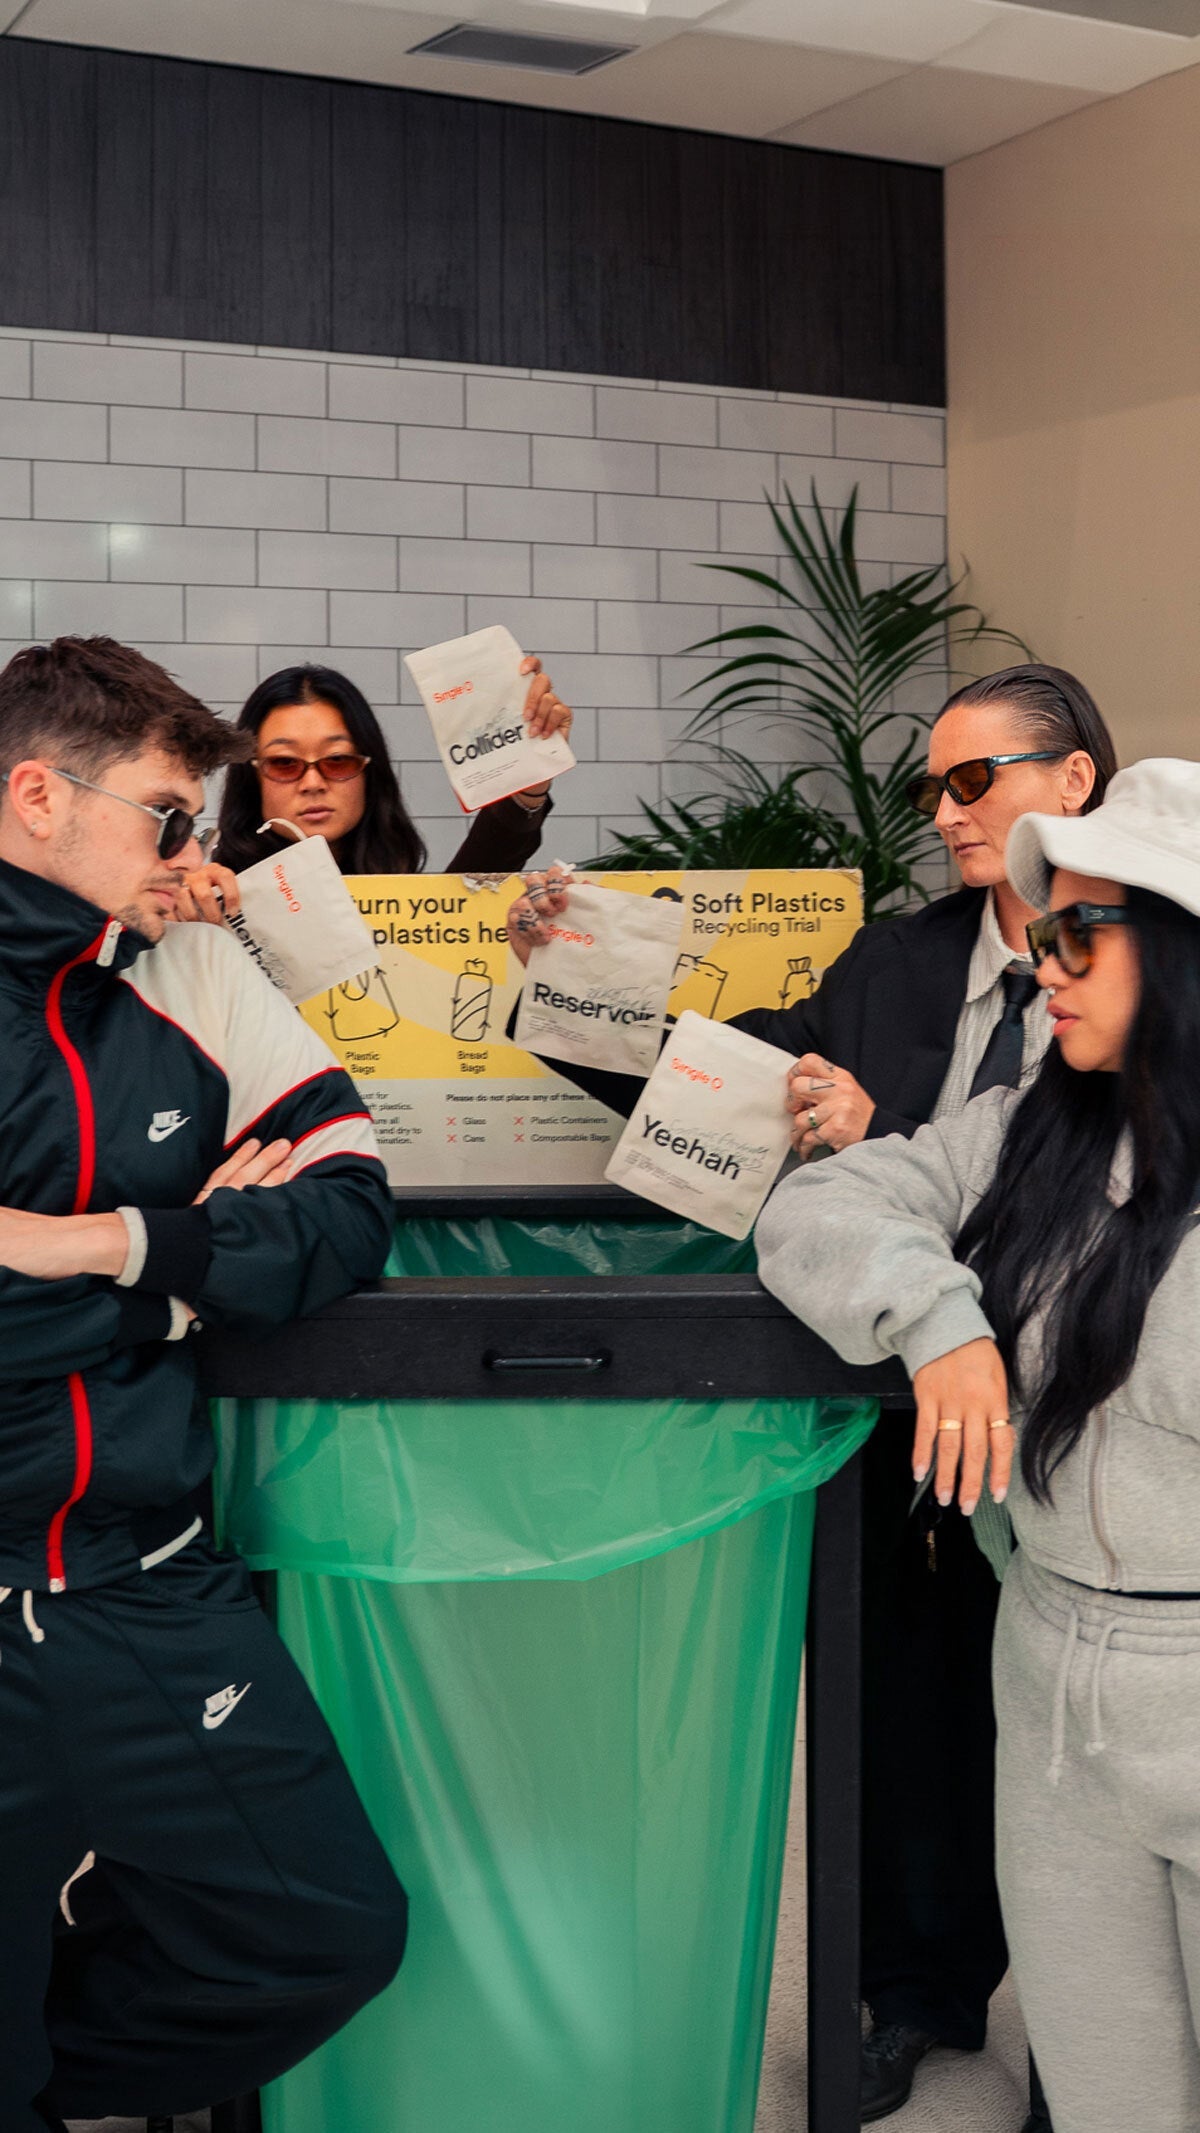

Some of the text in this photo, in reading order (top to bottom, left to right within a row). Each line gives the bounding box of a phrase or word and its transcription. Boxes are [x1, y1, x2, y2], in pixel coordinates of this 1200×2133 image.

[449, 725, 524, 765] Collider
[272, 864, 302, 913] Single O
[692, 892, 845, 913] Soft Plastics
[408, 898, 467, 919] your
[692, 917, 821, 937] Recycling Trial
[373, 922, 469, 947] plastics
[548, 924, 582, 943] Single
[345, 1051, 380, 1061] Plastic
[457, 1050, 488, 1060] Bread
[351, 1064, 375, 1075] Bags
[460, 1063, 486, 1074] Bags
[671, 1057, 724, 1092] Single O
[446, 1093, 474, 1102] Please
[477, 1093, 487, 1102] do
[490, 1094, 504, 1102] not
[506, 1093, 530, 1103] place
[533, 1094, 548, 1103] any
[550, 1093, 560, 1101] of
[561, 1093, 585, 1102] these
[463, 1117, 487, 1125] Glass
[531, 1116, 608, 1125] Plastic Containers
[378, 1127, 394, 1135] and
[397, 1126, 411, 1136] dry
[463, 1134, 486, 1143] Cans
[530, 1133, 612, 1144] Compostable Bags
[641, 1114, 741, 1180] Yeehah
